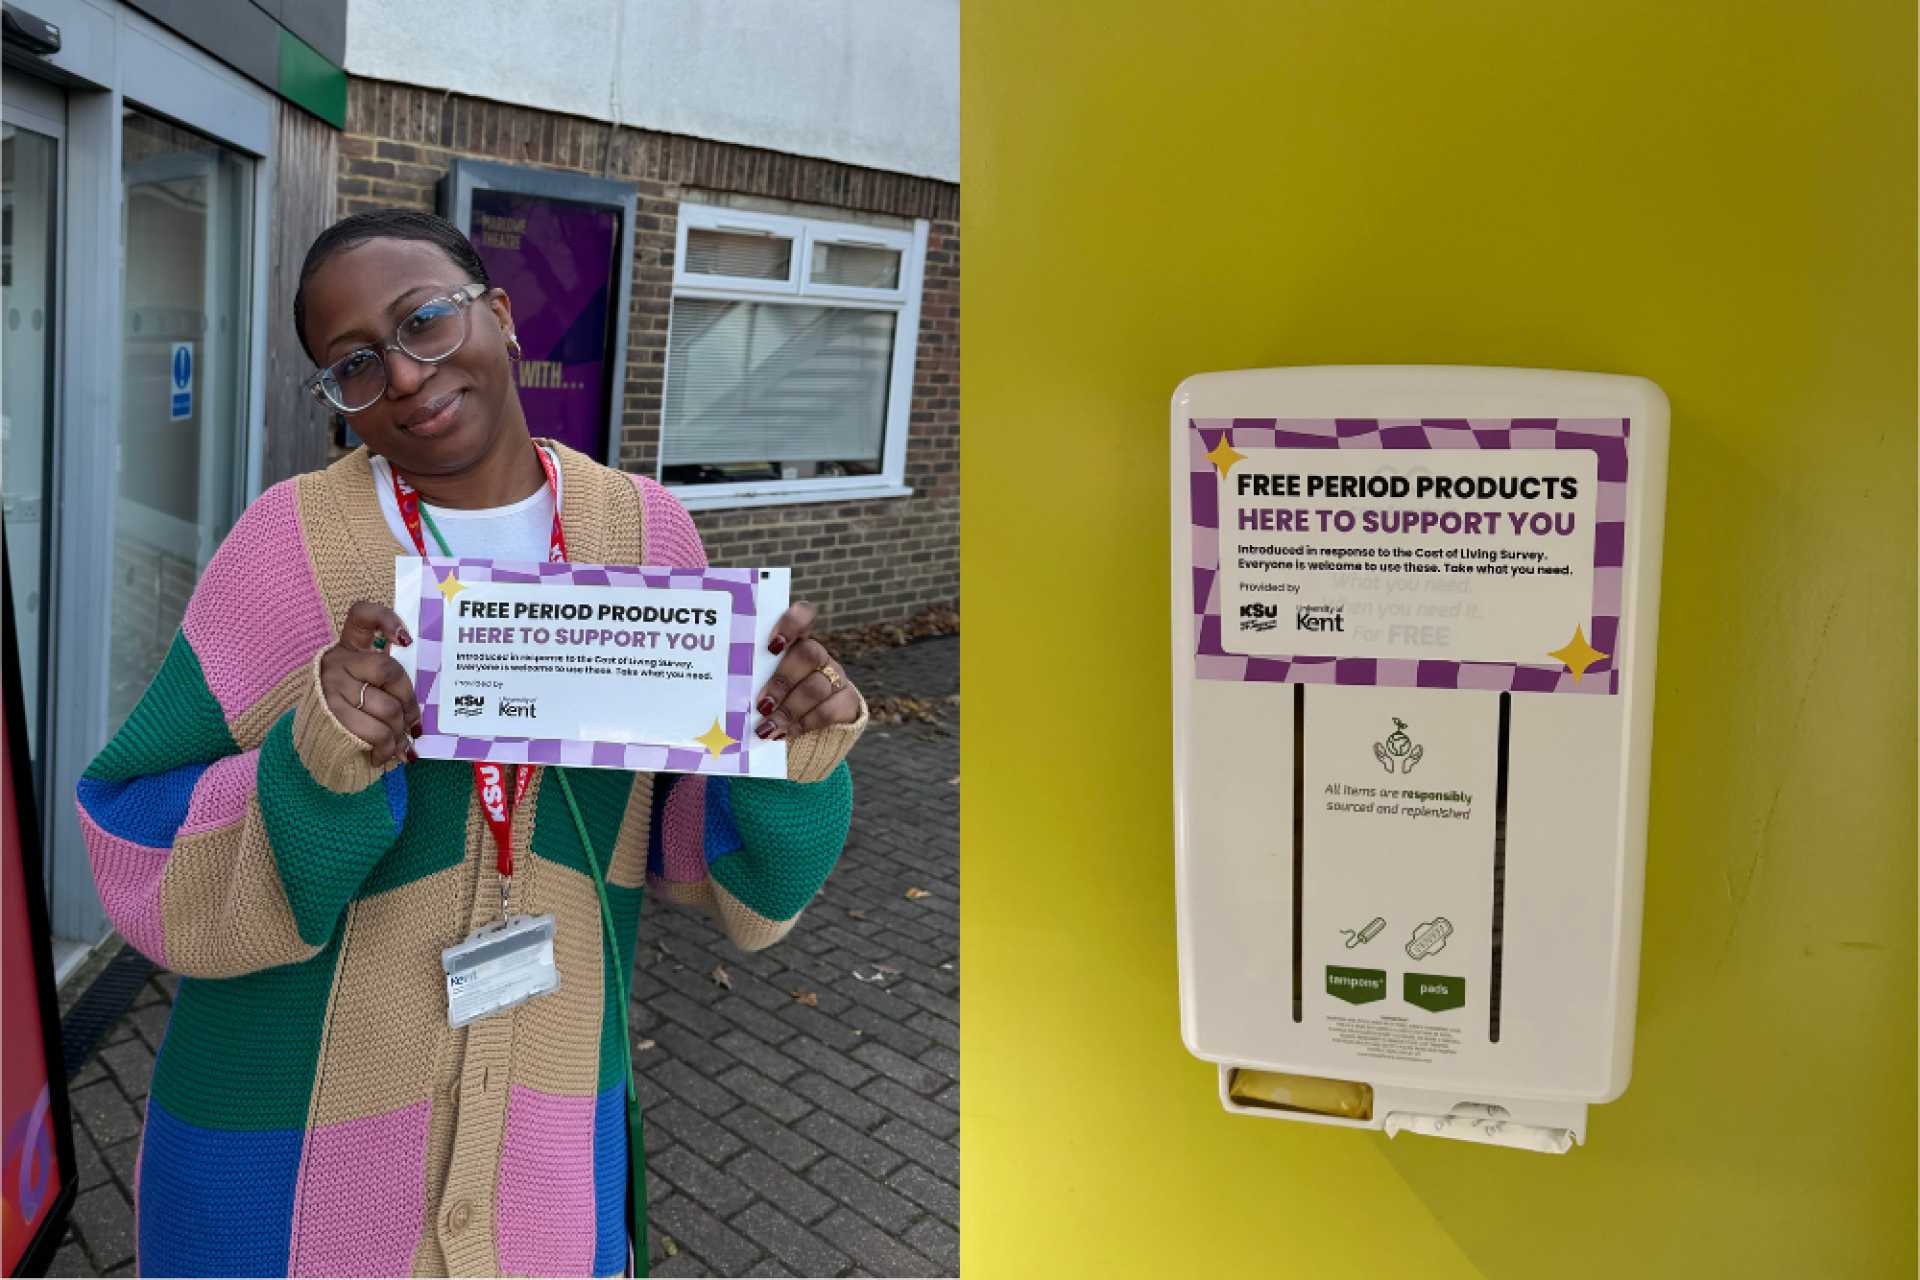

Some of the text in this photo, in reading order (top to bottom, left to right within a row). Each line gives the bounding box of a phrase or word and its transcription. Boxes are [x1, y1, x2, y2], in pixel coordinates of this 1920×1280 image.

[519, 361, 584, 389] WITH...
[1238, 474, 1578, 500] FREE PERIOD PRODUCTS
[1238, 508, 1310, 532] HERE
[1315, 509, 1356, 533] TO
[1362, 509, 1502, 535] SUPPORT
[1507, 511, 1575, 536] YOU
[1238, 544, 1548, 562] Introduced in response to the Cost of Living Survey.
[1238, 558, 1573, 577] Everyone is welcome to use these. Take what you need.
[1239, 582, 1301, 595] Provided by
[459, 600, 717, 626] FREE PERIOD PRODUCTS
[1240, 602, 1277, 618] KSU
[1296, 612, 1345, 632] Kent
[458, 627, 715, 651] HERE TO SUPPORT YOU
[456, 652, 694, 670] Introduced in response to the Cost of Living Survey.
[456, 663, 500, 673] Everyone
[501, 663, 510, 672] is
[510, 664, 553, 674] welcome
[554, 665, 564, 674] to
[565, 666, 584, 675] use
[615, 667, 638, 676] Take
[641, 668, 665, 678] what
[665, 671, 684, 680] you
[686, 671, 713, 680] need.
[498, 701, 537, 718] Kent
[480, 766, 506, 822] KSU
[1325, 783, 1341, 795] All
[1379, 789, 1400, 798] are
[1401, 789, 1473, 805] responsibly
[1326, 801, 1472, 819] sourced and replenished
[450, 970, 478, 987] Kent
[1420, 983, 1449, 996] pads
